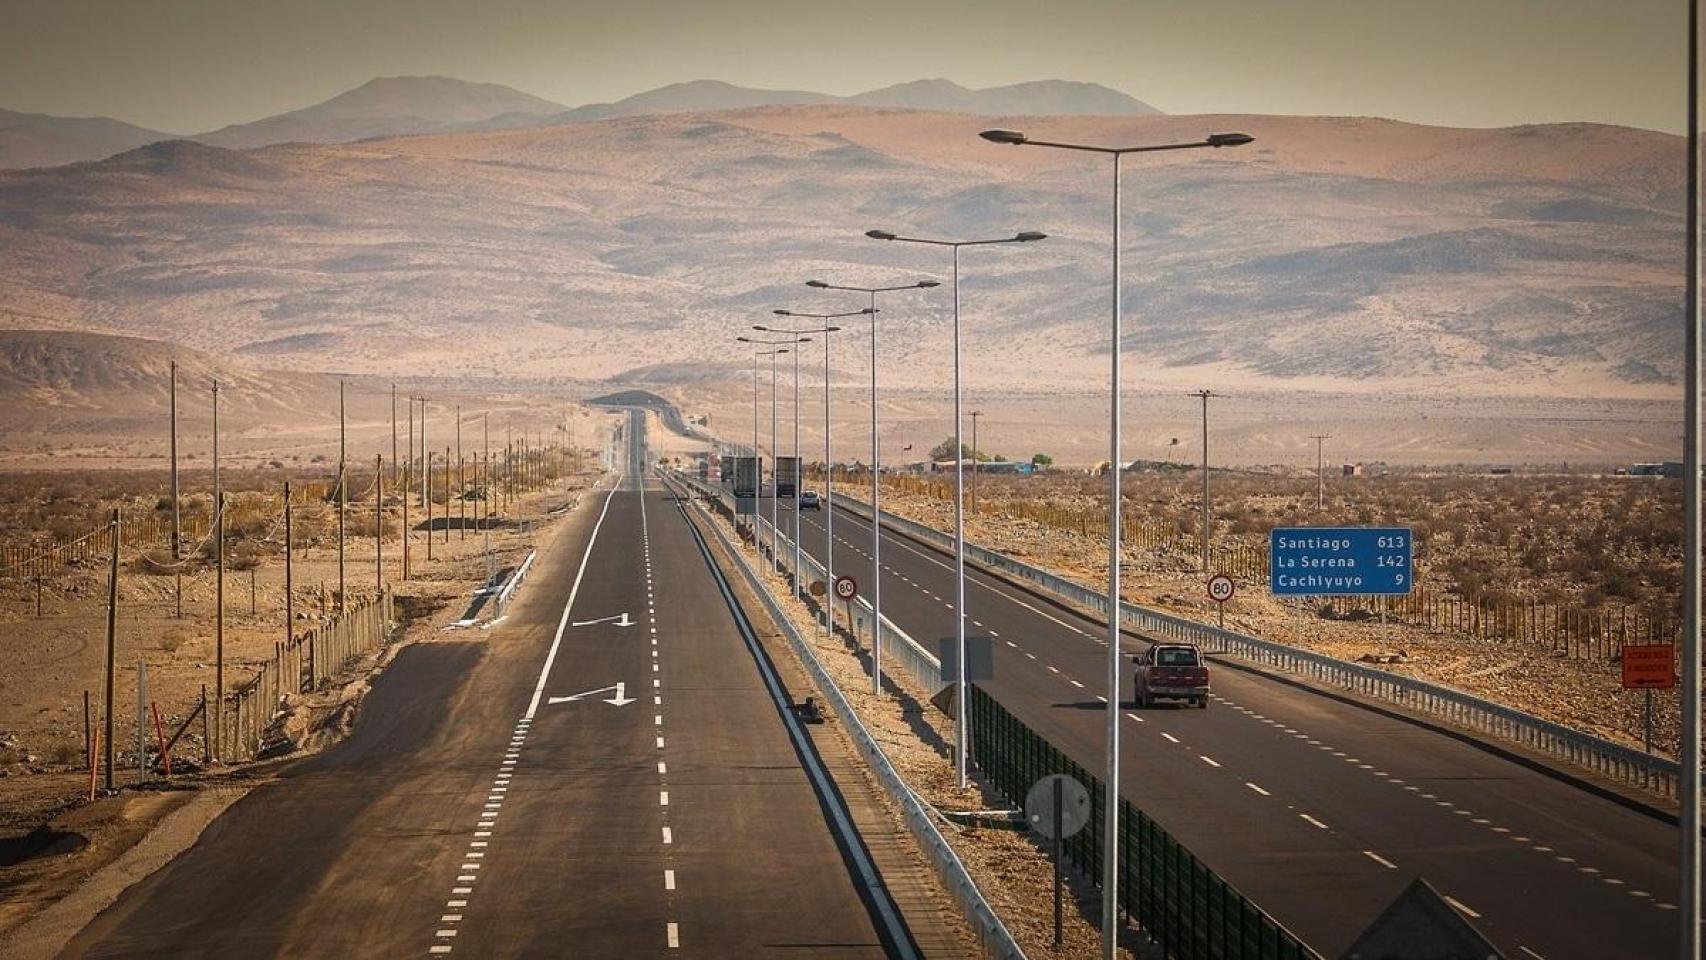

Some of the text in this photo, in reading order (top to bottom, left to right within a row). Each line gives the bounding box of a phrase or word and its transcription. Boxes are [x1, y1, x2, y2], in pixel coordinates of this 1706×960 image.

[1279, 536, 1404, 551] Santiago 613
[1278, 556, 1404, 568] La Serena 142
[1279, 574, 1404, 588] Cachiyuyo 9
[840, 582, 851, 593] 80
[1213, 582, 1229, 594] 80
